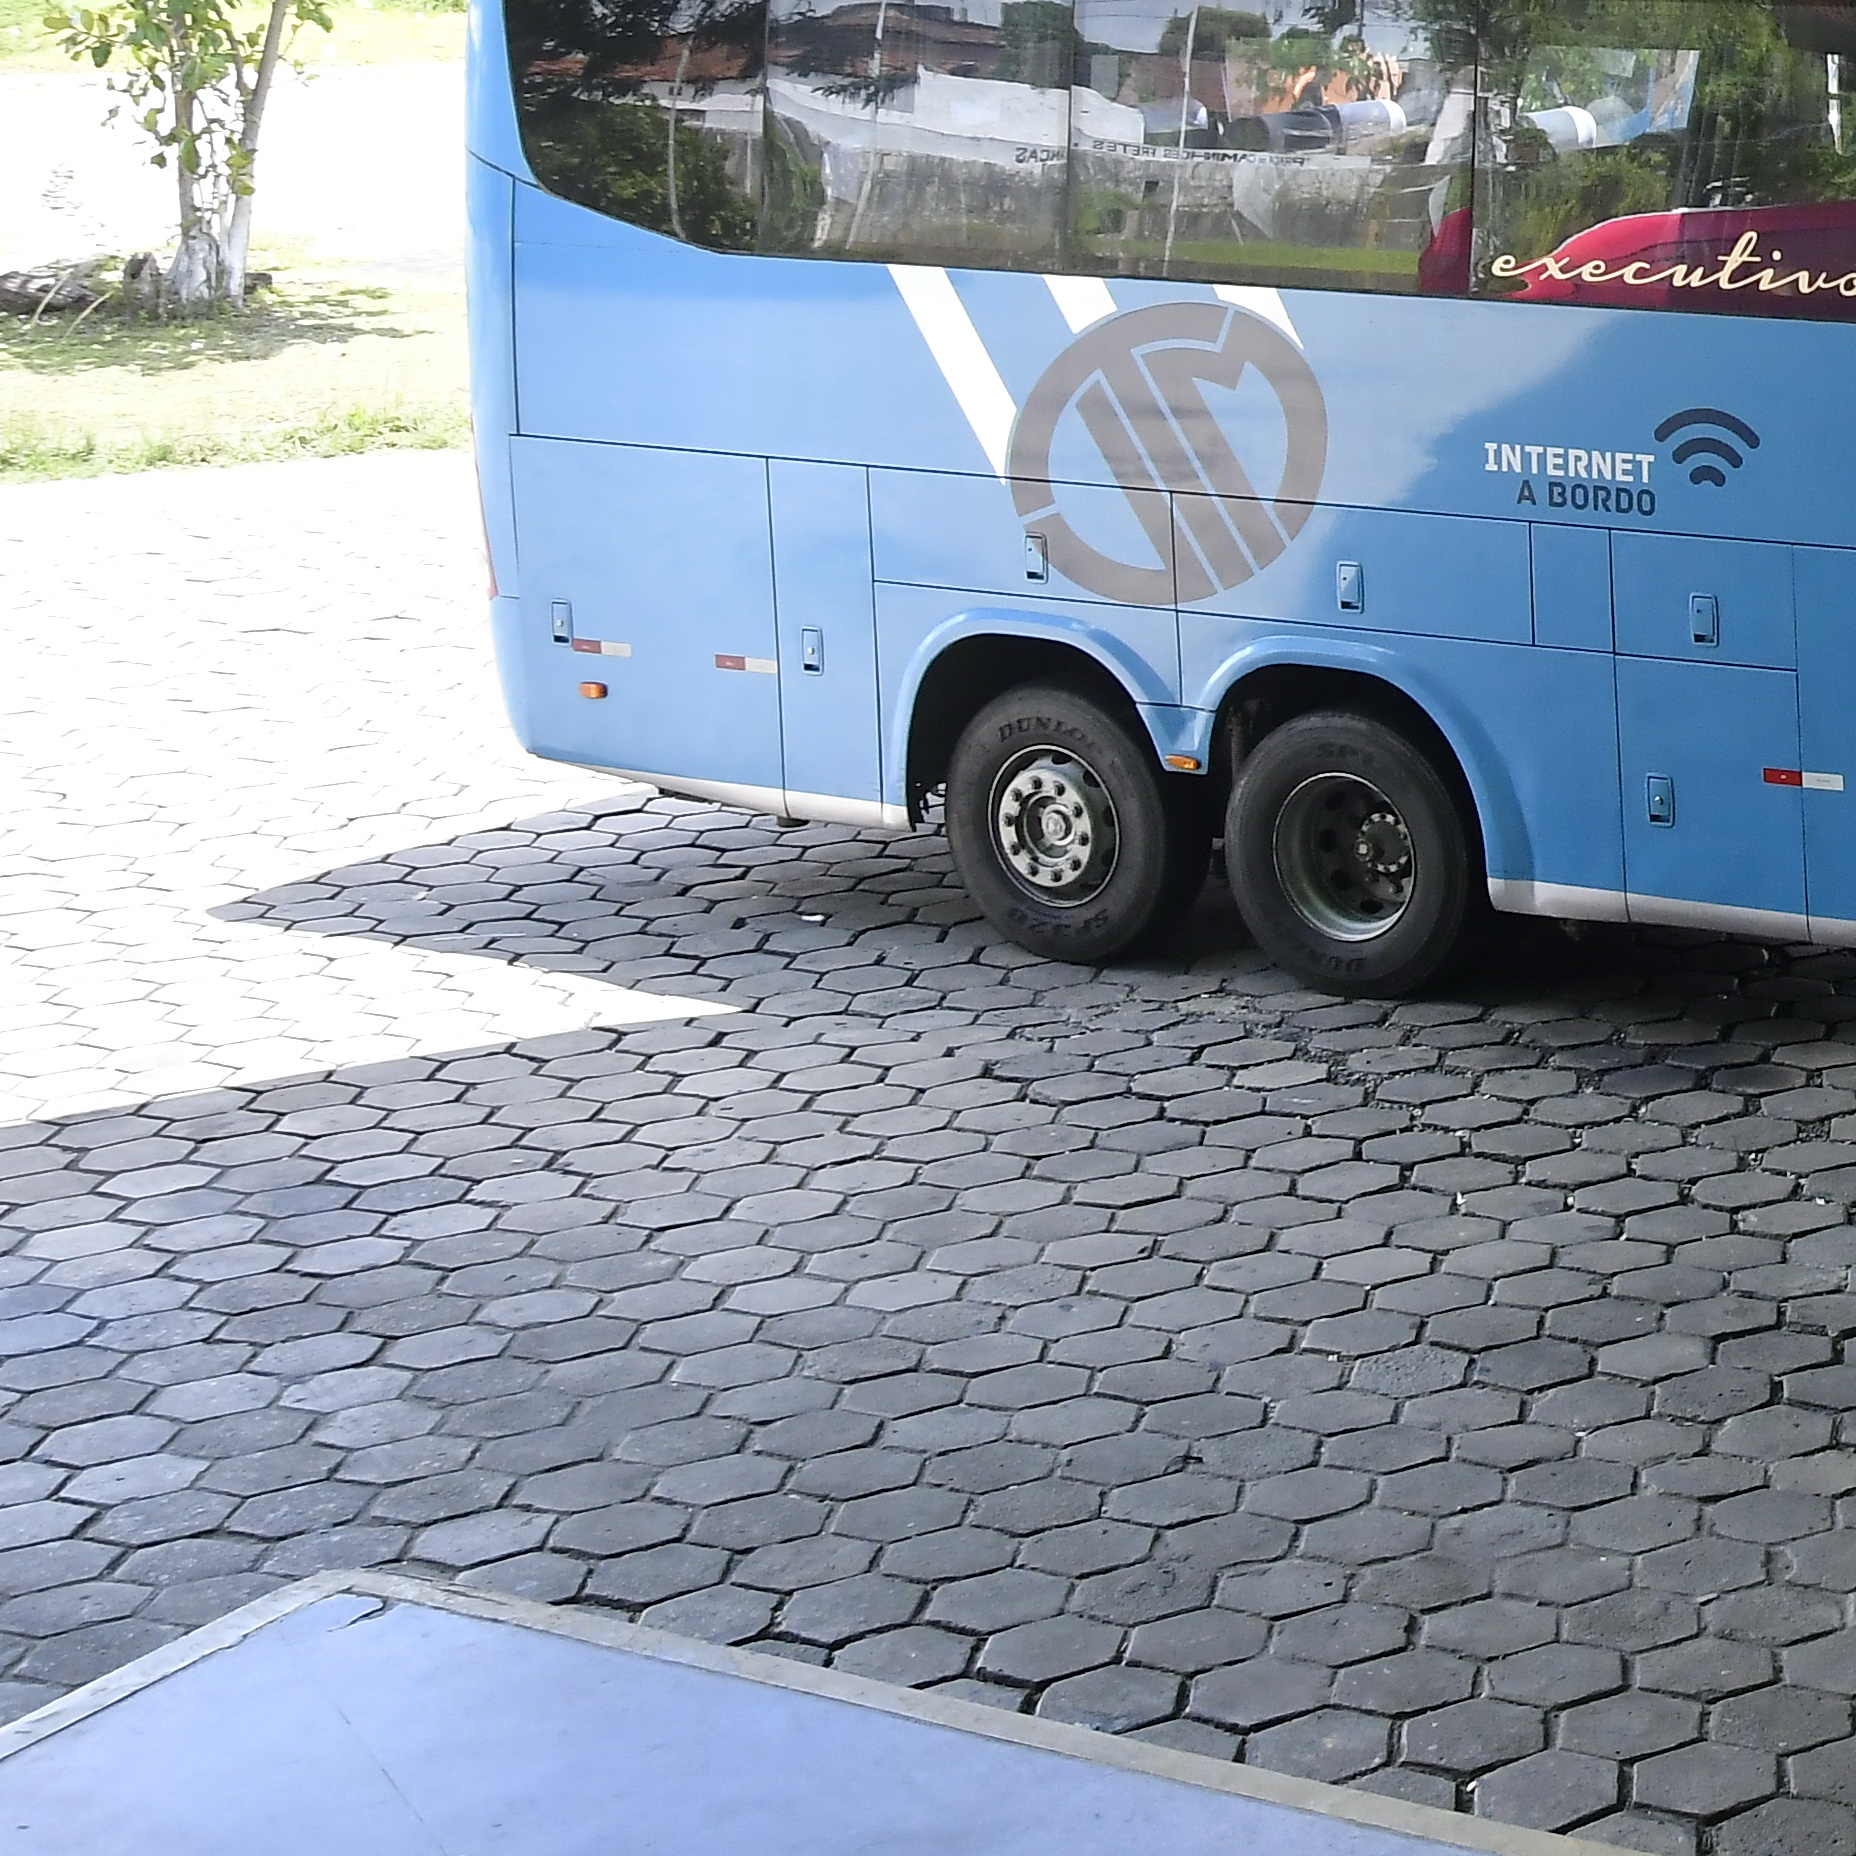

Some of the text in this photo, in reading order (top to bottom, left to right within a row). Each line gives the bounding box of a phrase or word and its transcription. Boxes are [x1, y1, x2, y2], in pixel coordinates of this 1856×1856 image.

[1484, 442, 1656, 483] INTERNET
[1516, 479, 1656, 517] A BORDO
